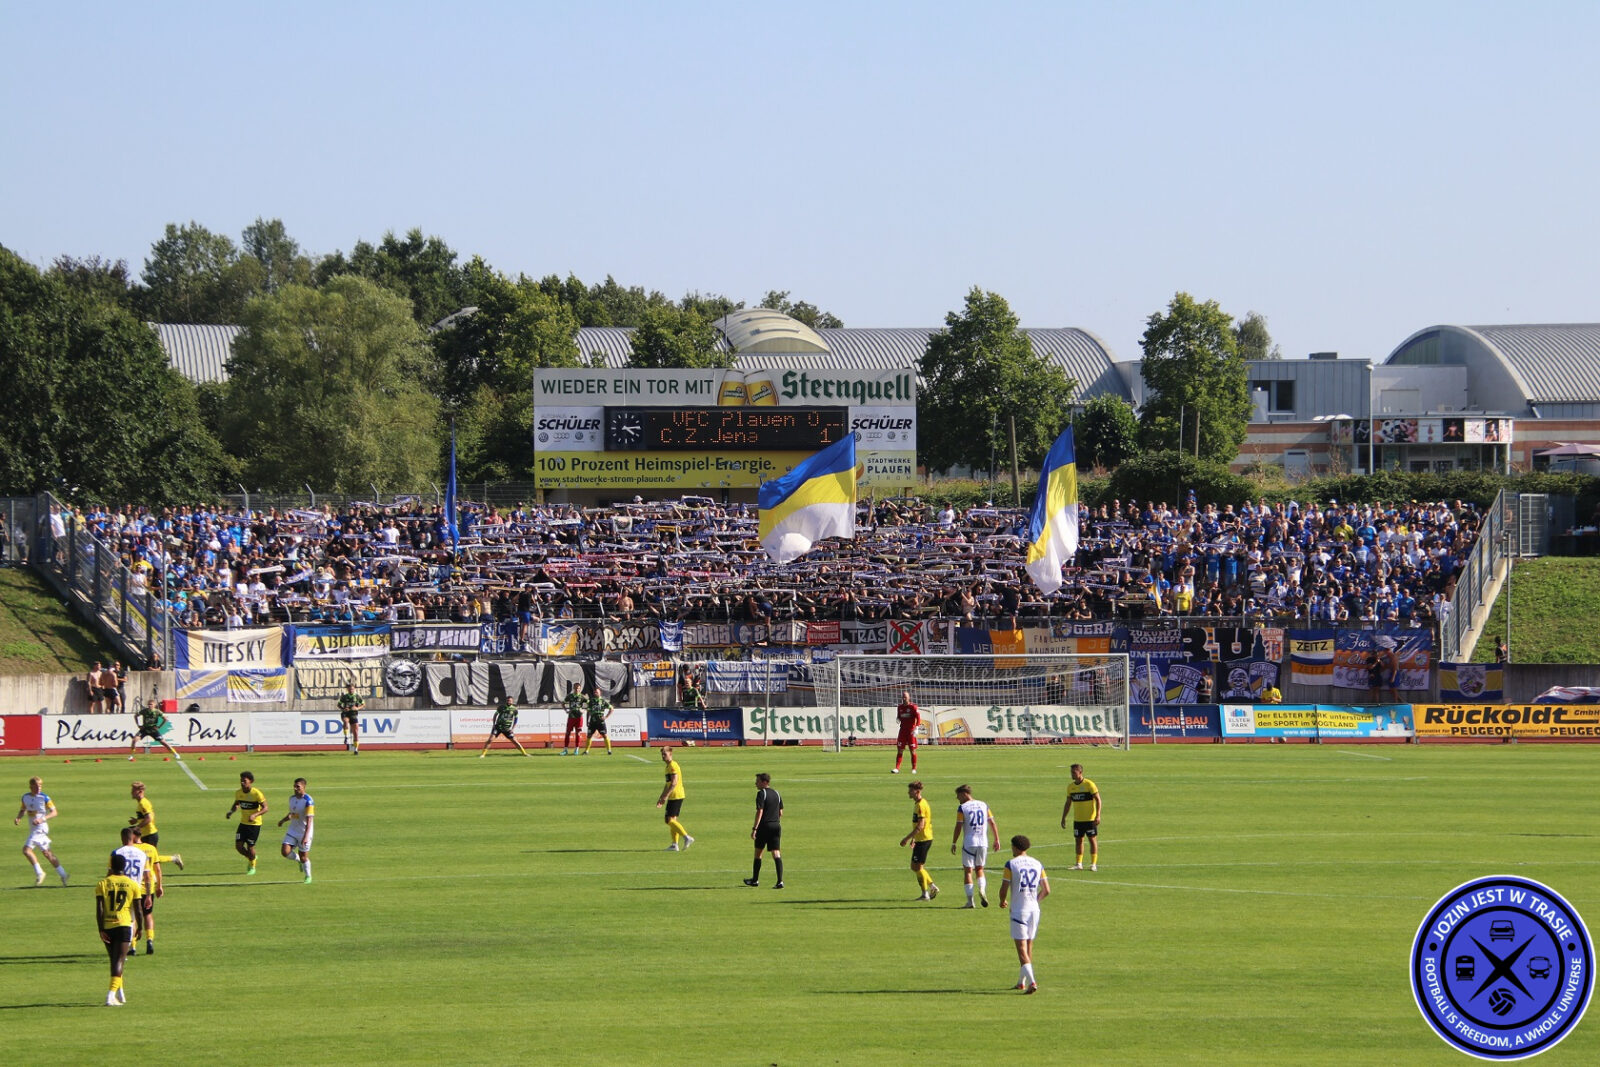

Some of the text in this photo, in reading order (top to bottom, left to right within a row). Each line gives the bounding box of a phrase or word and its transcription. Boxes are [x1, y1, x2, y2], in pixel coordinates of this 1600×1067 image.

[541, 379, 713, 394] WIEDER EIN TOR MIT
[781, 370, 912, 405] Sternquell
[538, 415, 600, 430] SCHÜLER
[673, 411, 709, 426] VFC
[722, 411, 795, 426] Plauen
[851, 415, 912, 430] SCHÜLER
[820, 428, 831, 443] 1
[538, 457, 776, 474] 100 Prozent Heimspiel-Energie.
[539, 475, 675, 485] www.stadtwerke-strom-plauen.de
[1073, 622, 1114, 635] GERA
[329, 634, 375, 649] BLOCK
[439, 629, 480, 647] MIND
[1088, 639, 1127, 650] JENA
[204, 639, 266, 663] NIESKY
[973, 643, 1017, 654] WEIMAR
[1297, 641, 1328, 652] ZEITZ
[298, 669, 382, 688] WOLFPACK
[749, 706, 885, 736] Sternquell
[987, 705, 1119, 737] Sternquell
[1187, 716, 1208, 725] BAU
[1425, 706, 1572, 724] Rückoldt
[57, 719, 135, 744] Plauen
[187, 717, 238, 742] Park
[664, 720, 730, 729] LADEN BAU
[1451, 727, 1511, 735] PEUGEOT
[968, 809, 984, 827] 28
[124, 859, 141, 877] 25
[1019, 868, 1038, 888] 32
[108, 890, 127, 911] 19
